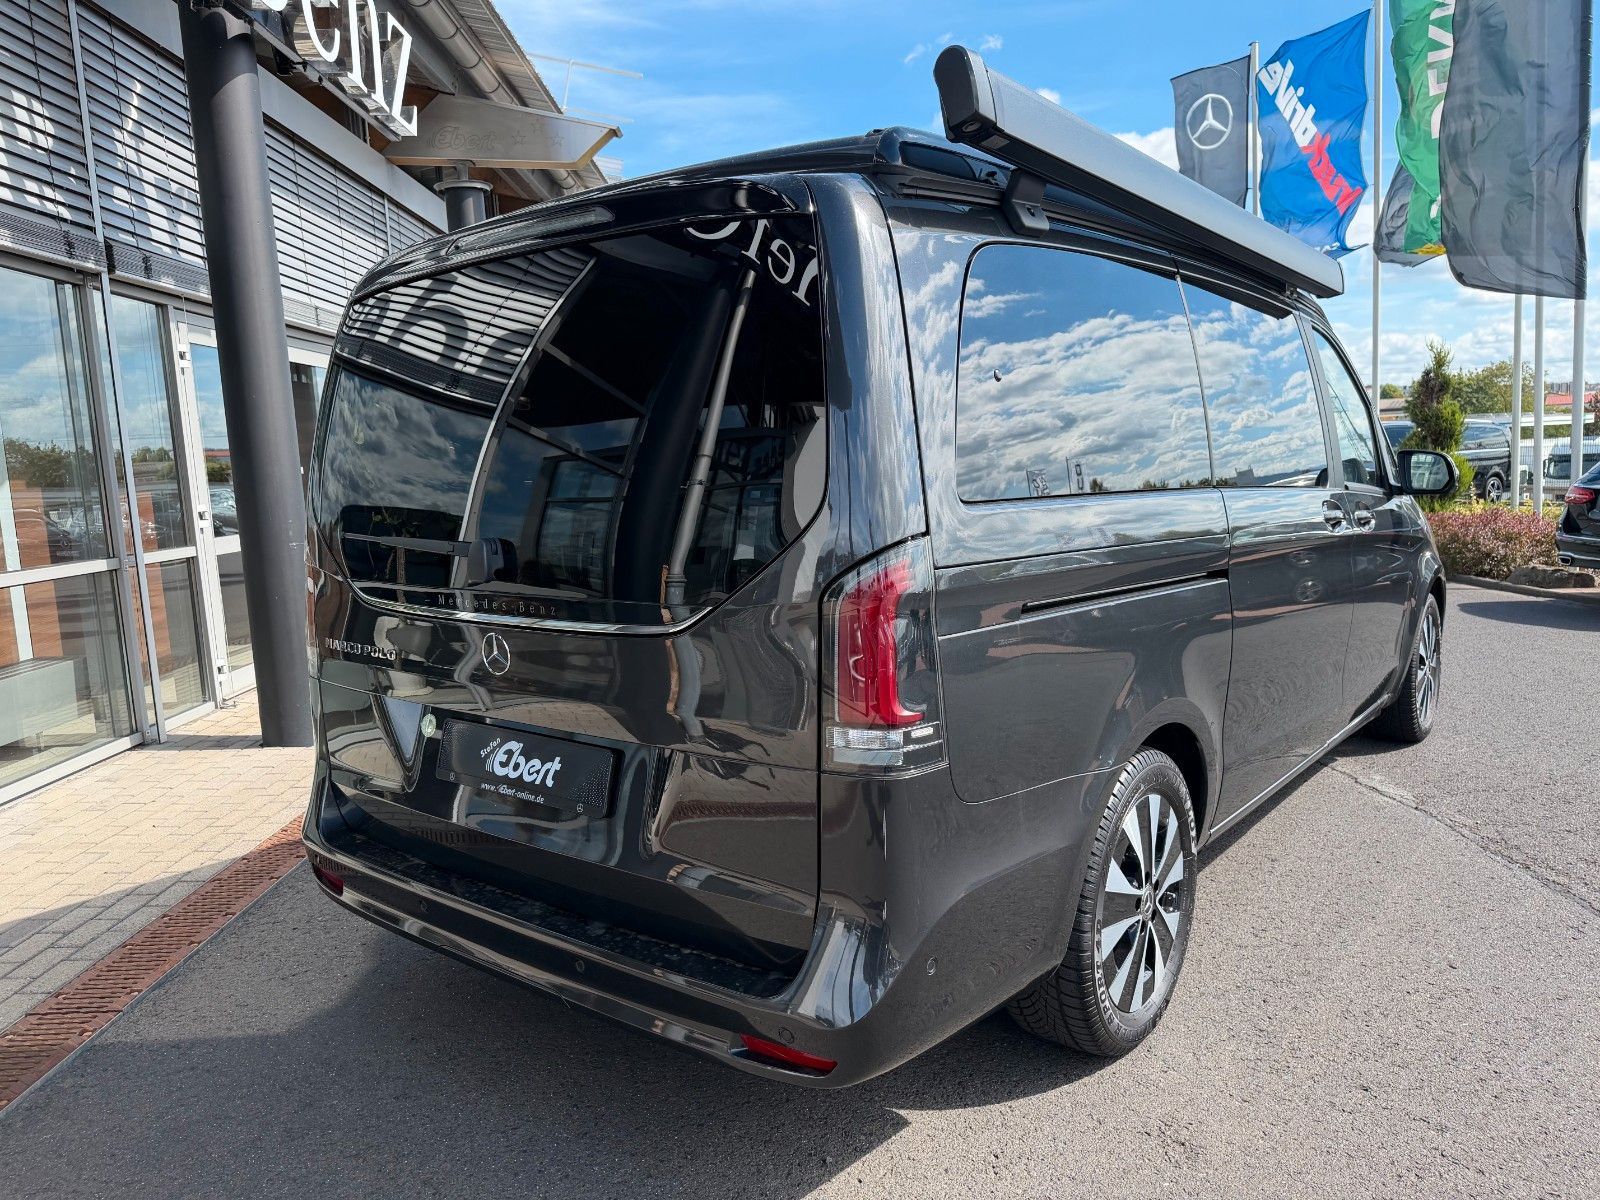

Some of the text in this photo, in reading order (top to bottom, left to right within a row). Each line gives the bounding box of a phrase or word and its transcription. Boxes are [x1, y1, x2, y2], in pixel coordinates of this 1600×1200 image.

[325, 637, 397, 661] MARCO POLO
[480, 737, 501, 758] Stefan
[493, 740, 562, 788] Ebert
